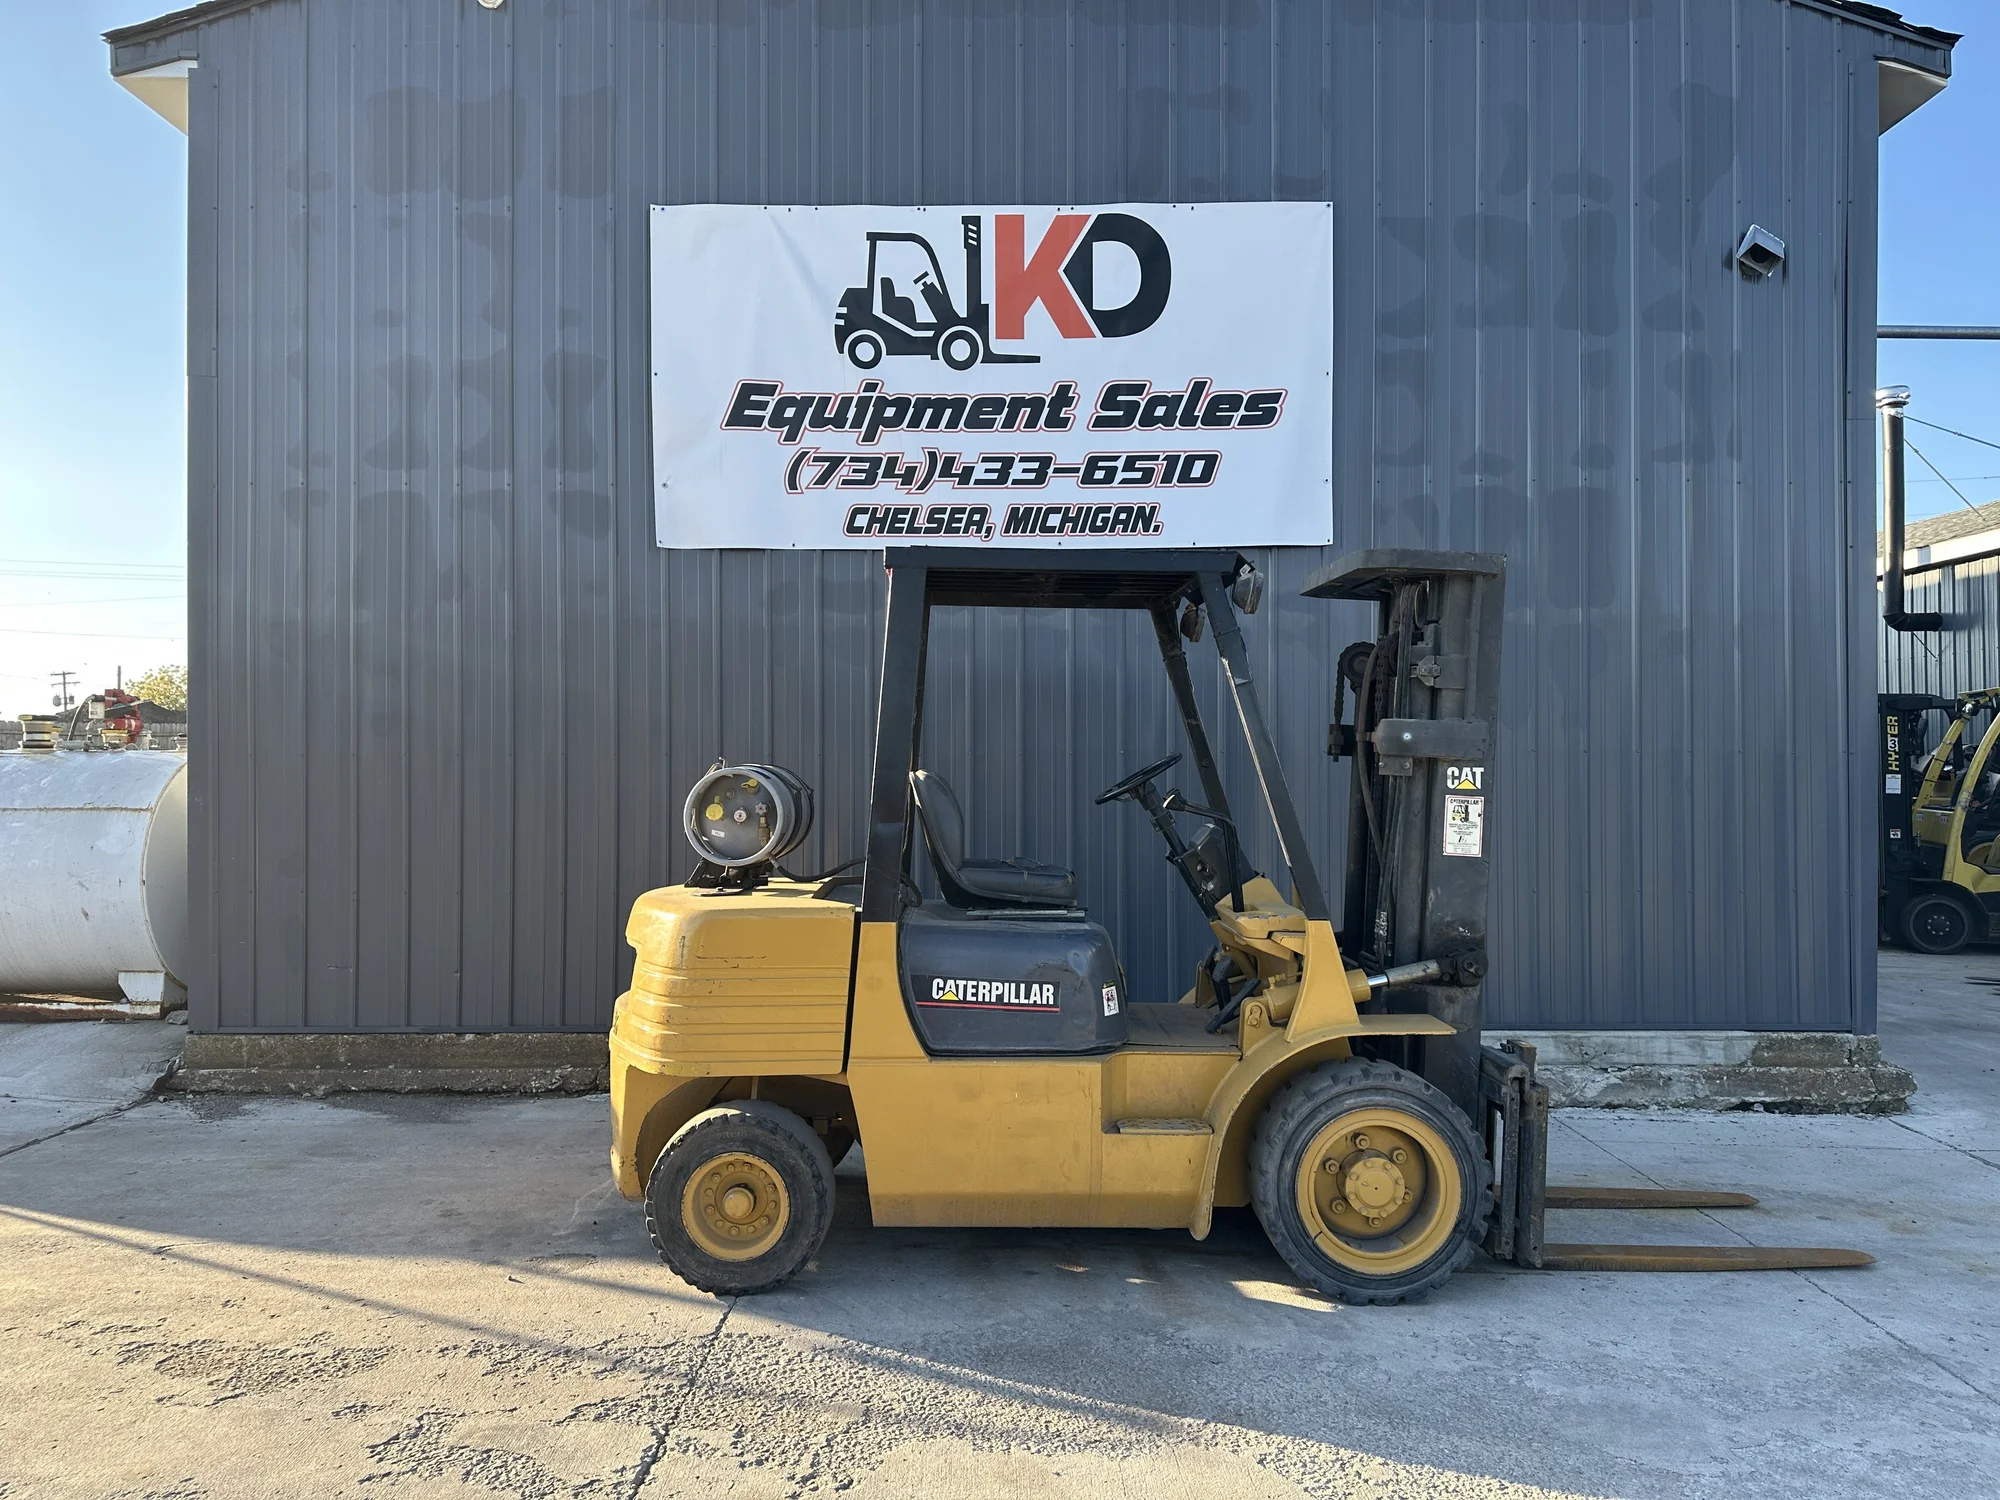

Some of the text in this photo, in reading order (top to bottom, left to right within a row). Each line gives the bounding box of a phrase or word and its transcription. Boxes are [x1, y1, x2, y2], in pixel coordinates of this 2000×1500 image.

[995, 213, 1171, 338] KD
[722, 379, 1286, 444] Equipment Sales
[786, 450, 1219, 493] (734)433-6510
[846, 503, 1161, 538] CHELSEA, MICHIGAN.
[1446, 766, 1485, 789] CAT
[932, 978, 1054, 1005] CATERPILLAR
